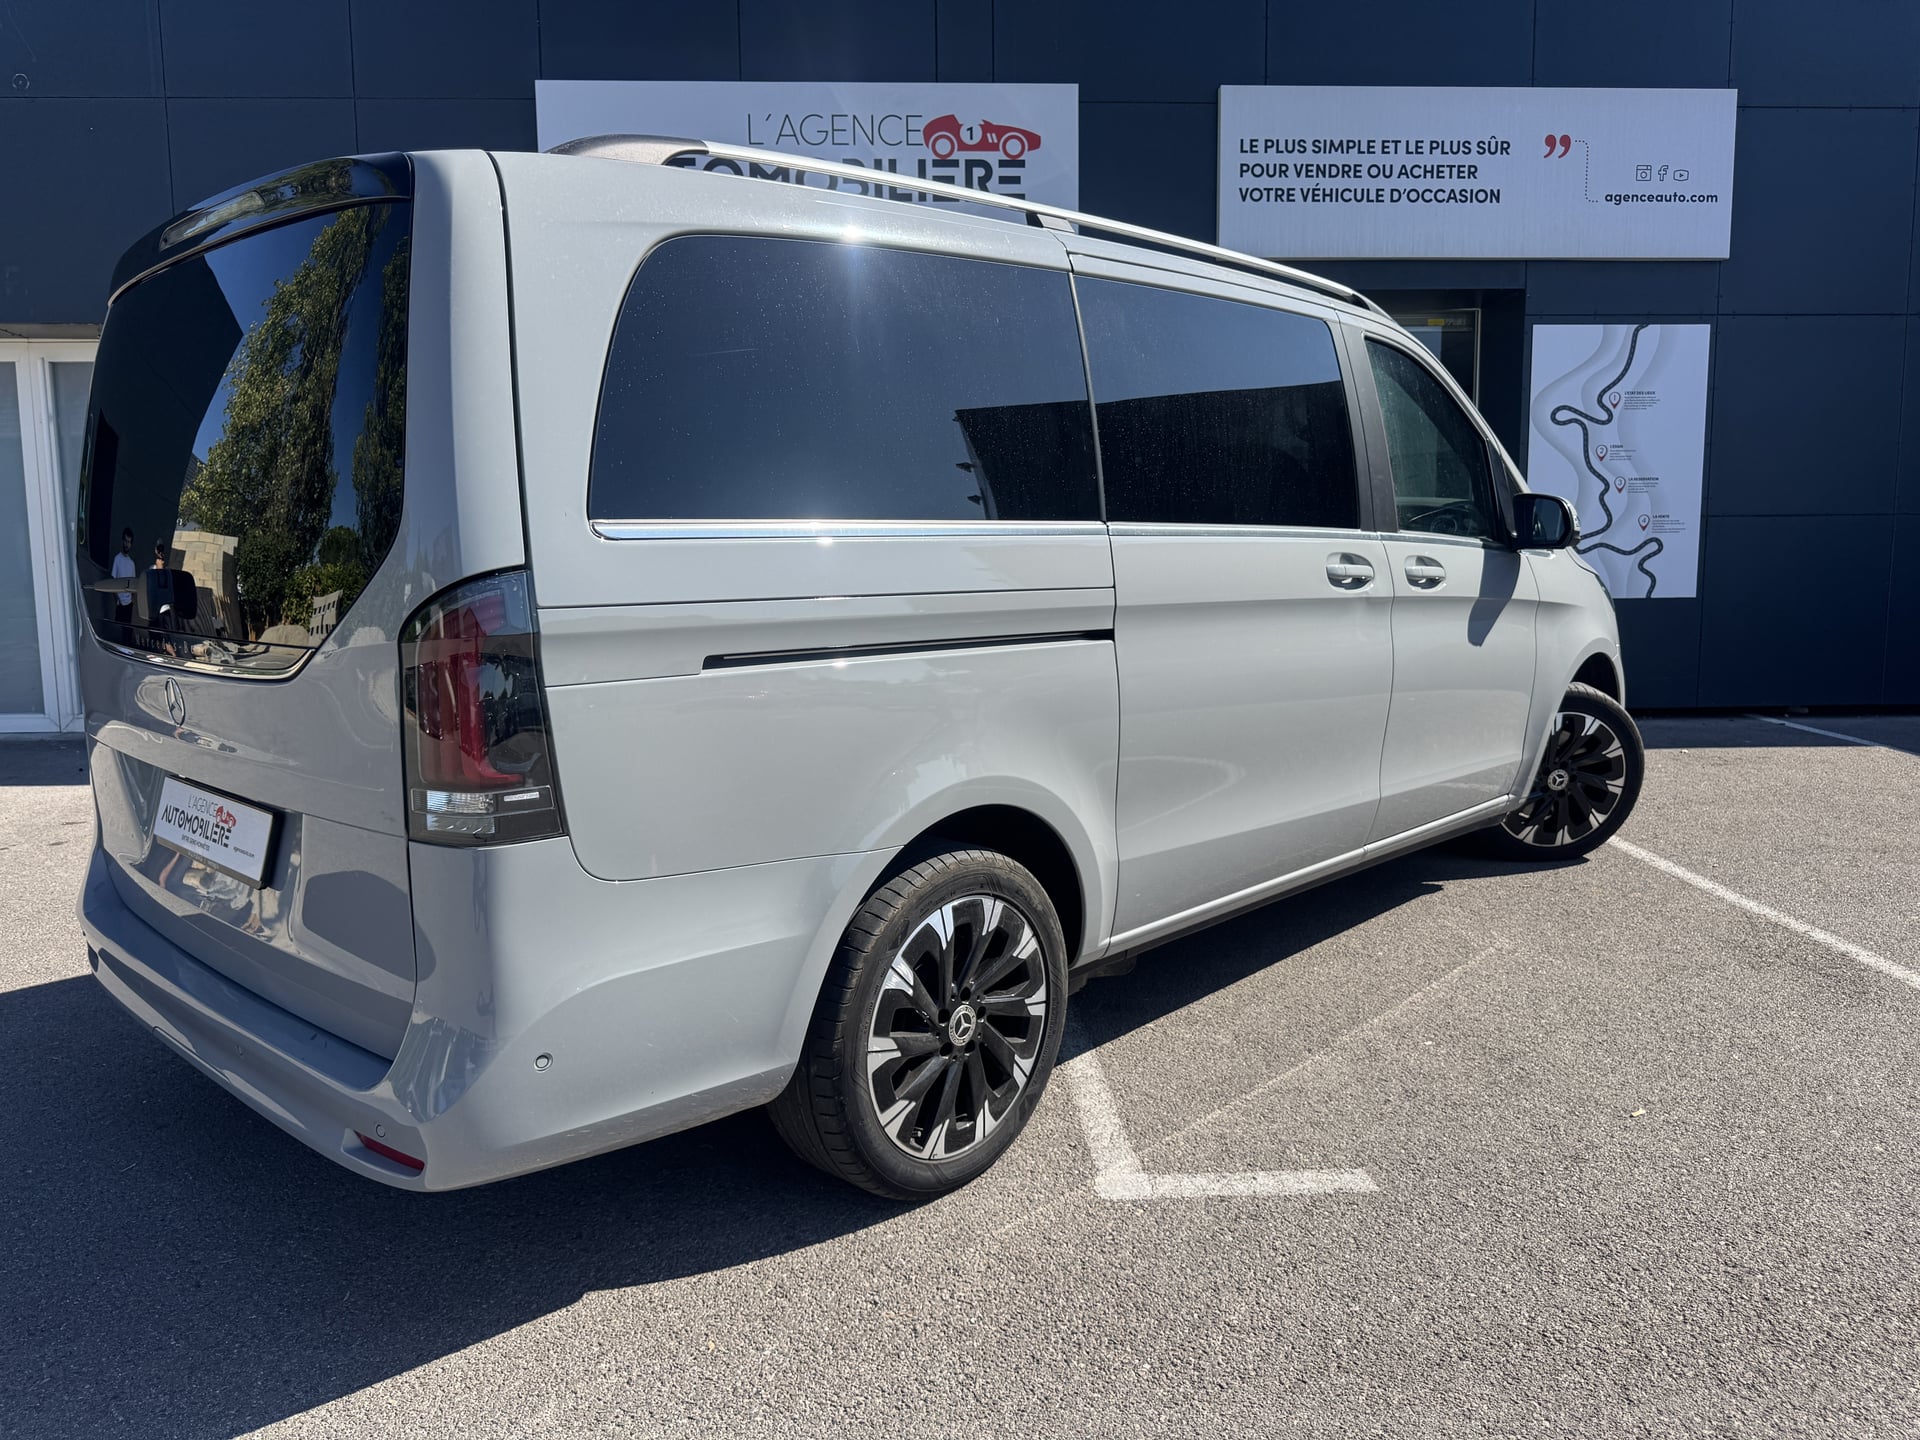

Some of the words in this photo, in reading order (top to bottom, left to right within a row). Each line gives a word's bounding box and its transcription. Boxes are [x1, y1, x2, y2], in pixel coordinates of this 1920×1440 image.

[747, 113, 923, 146] L'AGENCE
[1240, 138, 1259, 154] LE
[1263, 138, 1307, 154] PLUS
[1311, 138, 1376, 155] SIMPLE
[1380, 139, 1401, 155] ET
[1405, 139, 1424, 155] LE
[1429, 139, 1472, 155] PLUS
[1476, 135, 1511, 155] SÛR
[1239, 163, 1289, 179] POUR
[1293, 163, 1363, 179] VENDRE
[1367, 163, 1394, 179] OU
[1396, 164, 1479, 180] ACHETER
[1239, 187, 1296, 203] VOTRE
[1300, 182, 1385, 203] VÉHICULE
[1389, 187, 1501, 204] D'OCCASION
[1604, 191, 1718, 205] agenceauto.com
